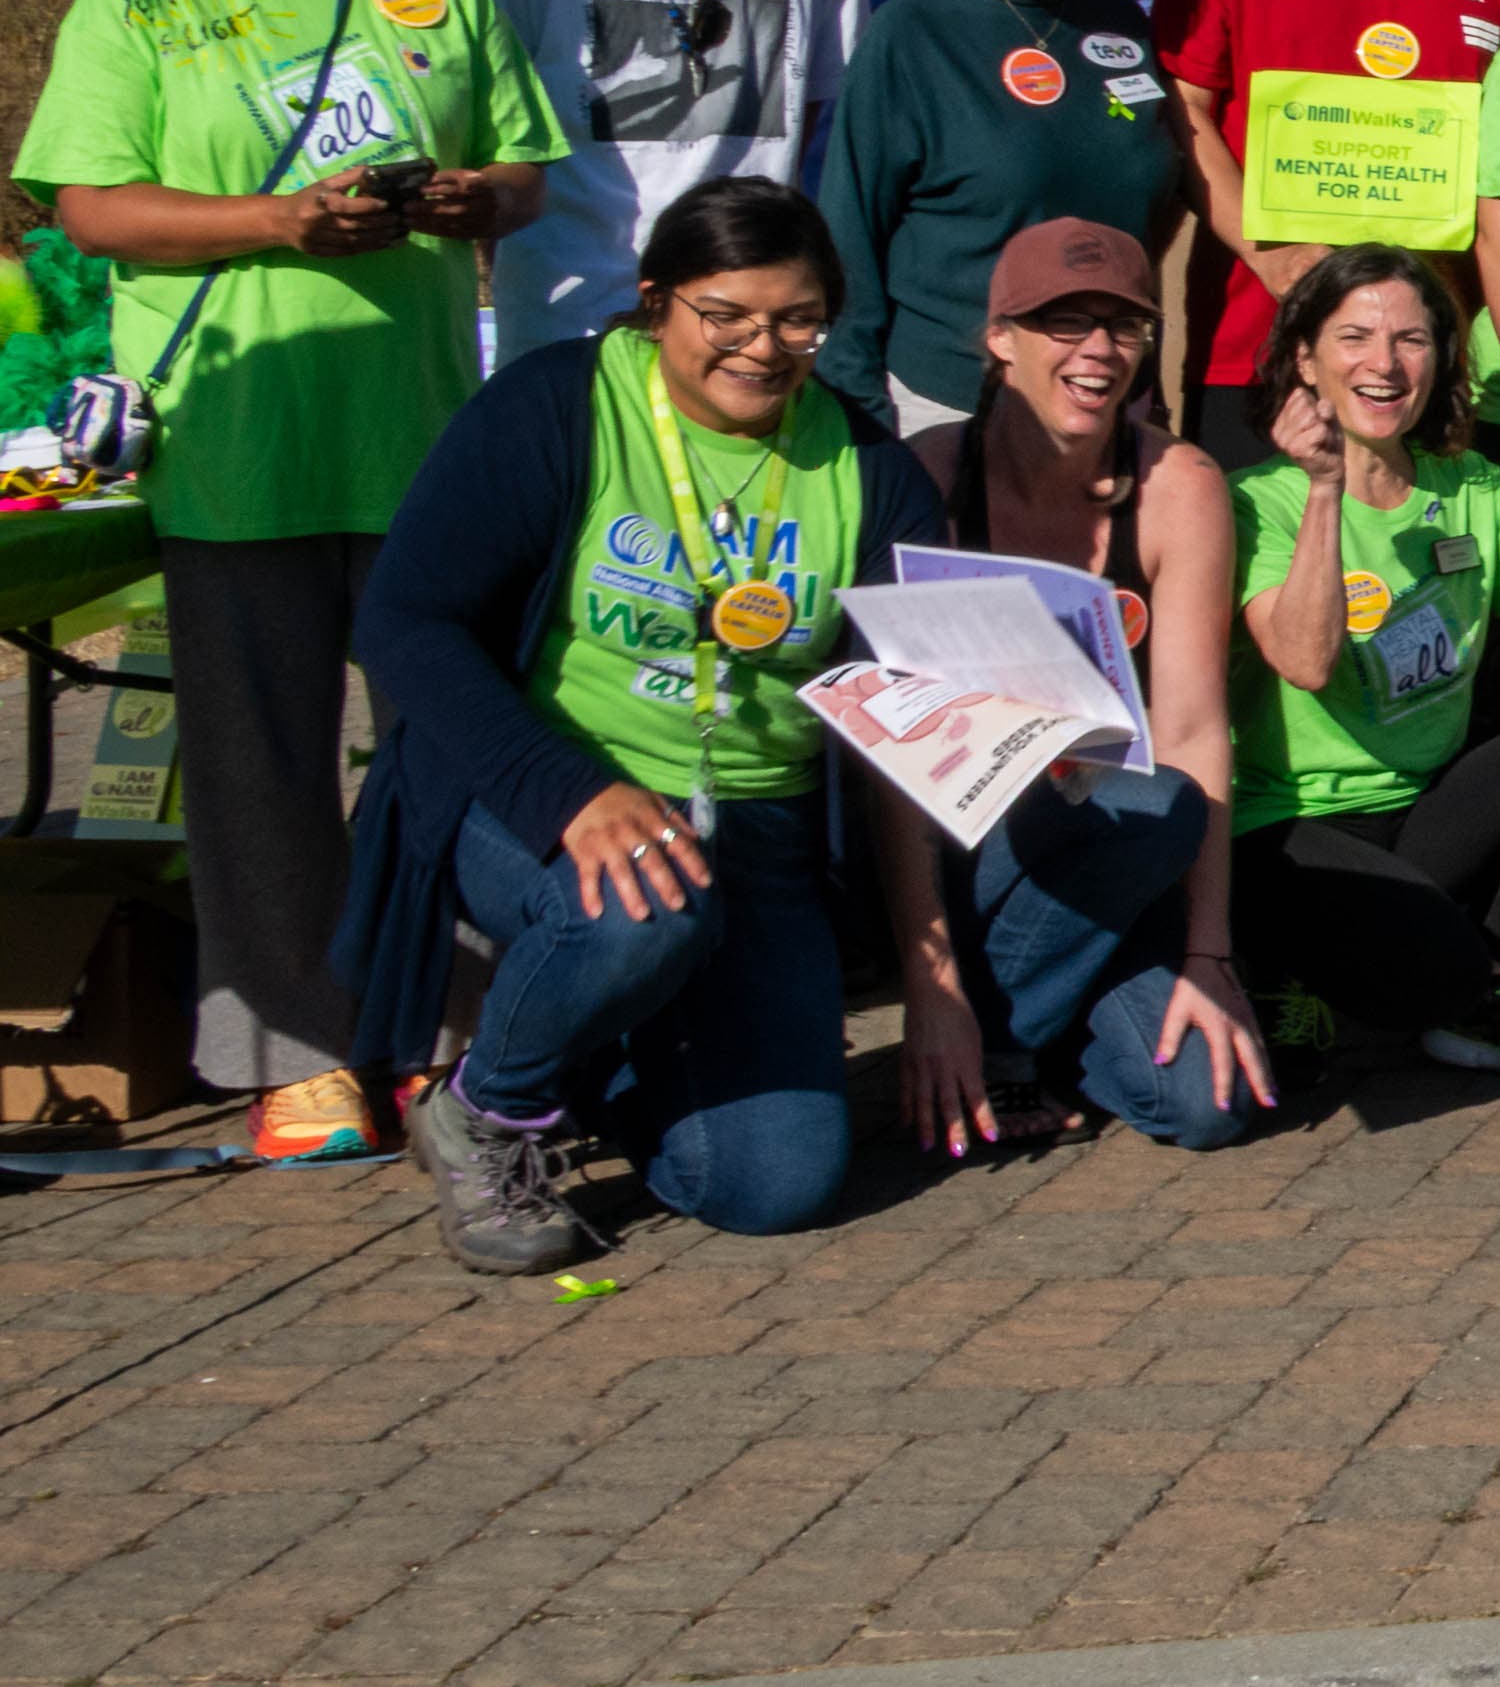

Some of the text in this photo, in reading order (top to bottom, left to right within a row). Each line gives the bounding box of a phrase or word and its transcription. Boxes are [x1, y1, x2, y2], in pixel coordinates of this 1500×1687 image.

[319, 90, 392, 158] all
[1312, 139, 1413, 161] SUPPORT
[1275, 158, 1447, 184] MENTAL HEALTH
[1317, 182, 1404, 202] FOR ALL
